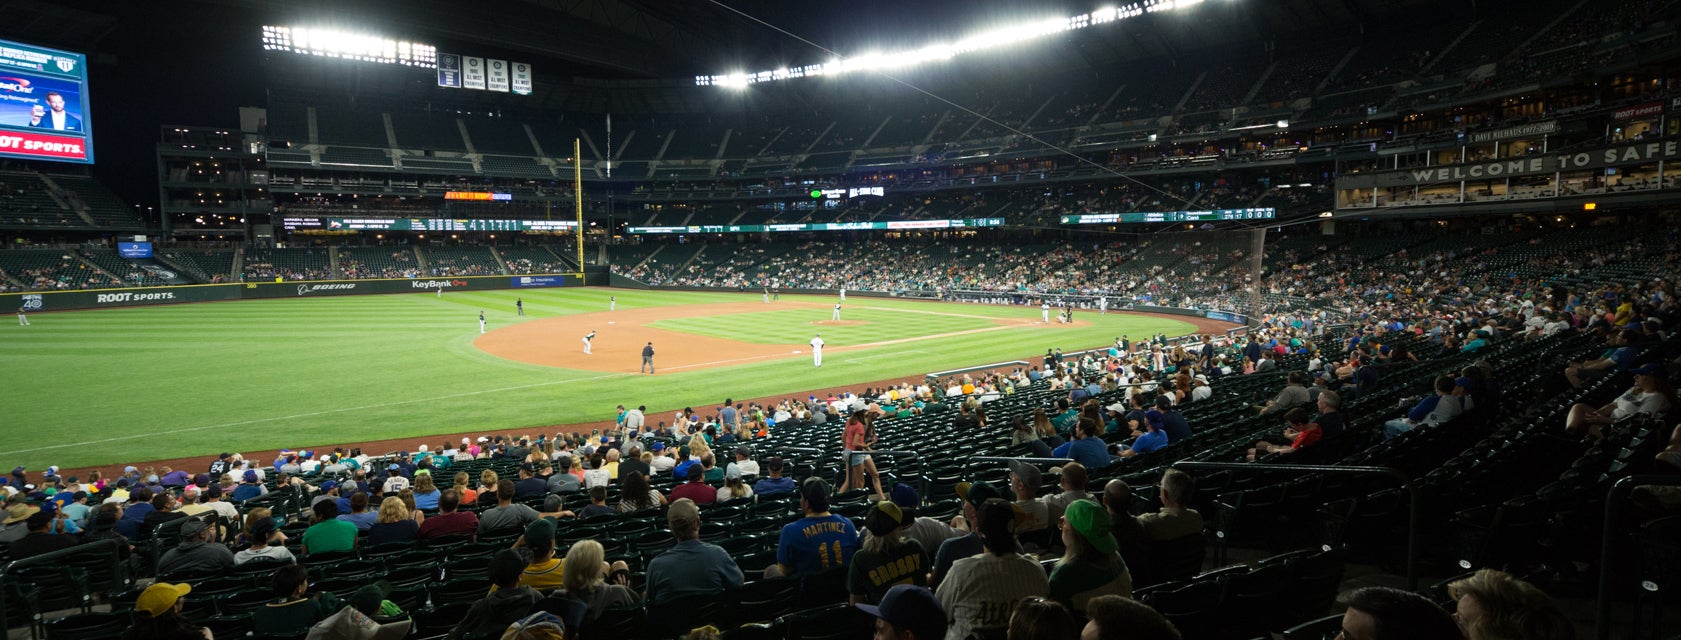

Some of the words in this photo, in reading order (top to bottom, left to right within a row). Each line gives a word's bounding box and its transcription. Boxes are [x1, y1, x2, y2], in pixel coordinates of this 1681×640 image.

[61, 62, 70, 70] 11
[1614, 109, 1636, 120] ROOT
[1475, 132, 1491, 142] DAVE
[1493, 128, 1522, 139] NIEHAUS
[1412, 157, 1543, 182] WELCOME
[1557, 152, 1591, 169] TO
[1604, 141, 1677, 164] SAFE
[412, 280, 452, 289] KeyBank
[97, 292, 133, 303] ROOT
[23, 300, 43, 309] 40
[211, 464, 224, 473] 24
[391, 483, 403, 492] 15
[803, 521, 846, 538] MARTINEZ
[818, 540, 843, 568] 11
[868, 553, 921, 587] CROSBY
